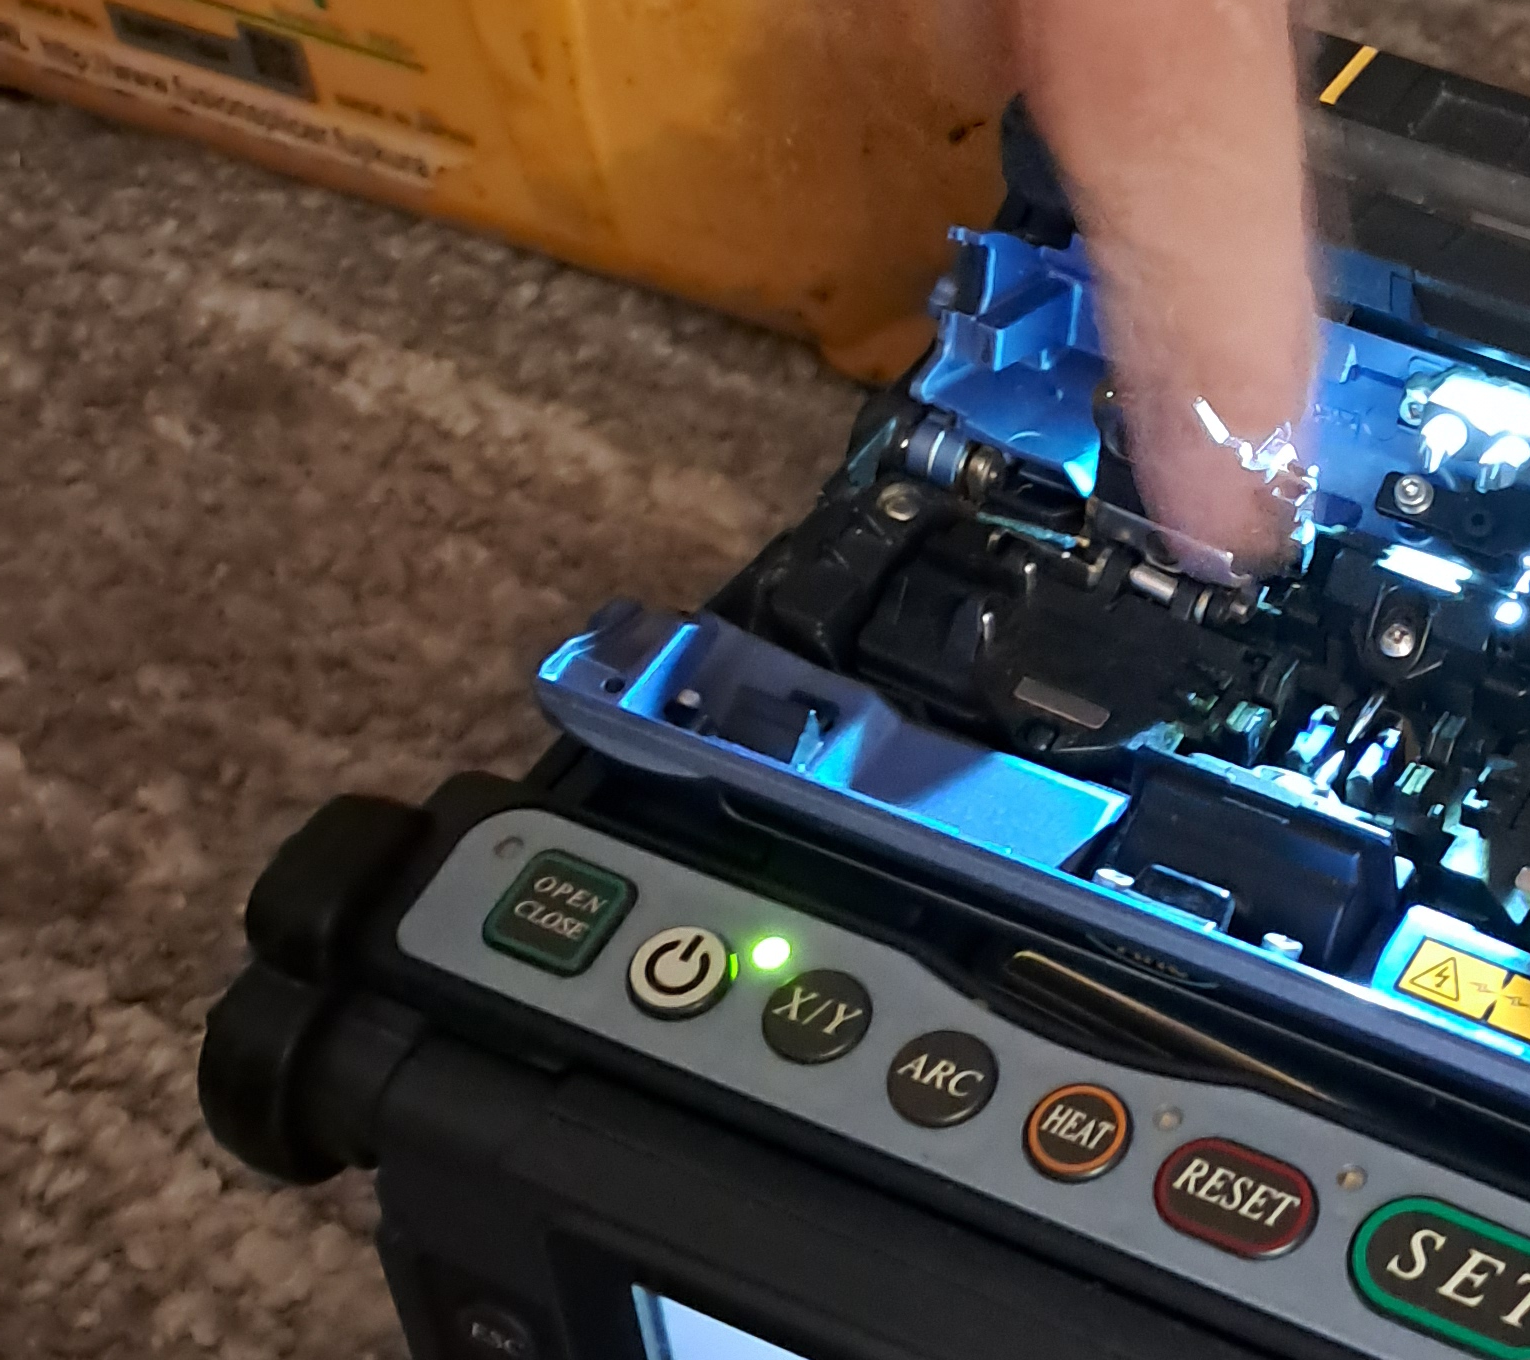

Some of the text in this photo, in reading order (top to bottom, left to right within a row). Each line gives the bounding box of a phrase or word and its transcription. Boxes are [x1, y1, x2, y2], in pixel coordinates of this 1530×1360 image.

[533, 874, 607, 915] OPEN
[513, 899, 590, 941] CLOSE
[772, 985, 864, 1036] X/Y
[896, 1052, 984, 1099] ARC
[1040, 1104, 1115, 1151] HEAT
[1172, 1158, 1300, 1228] RESET
